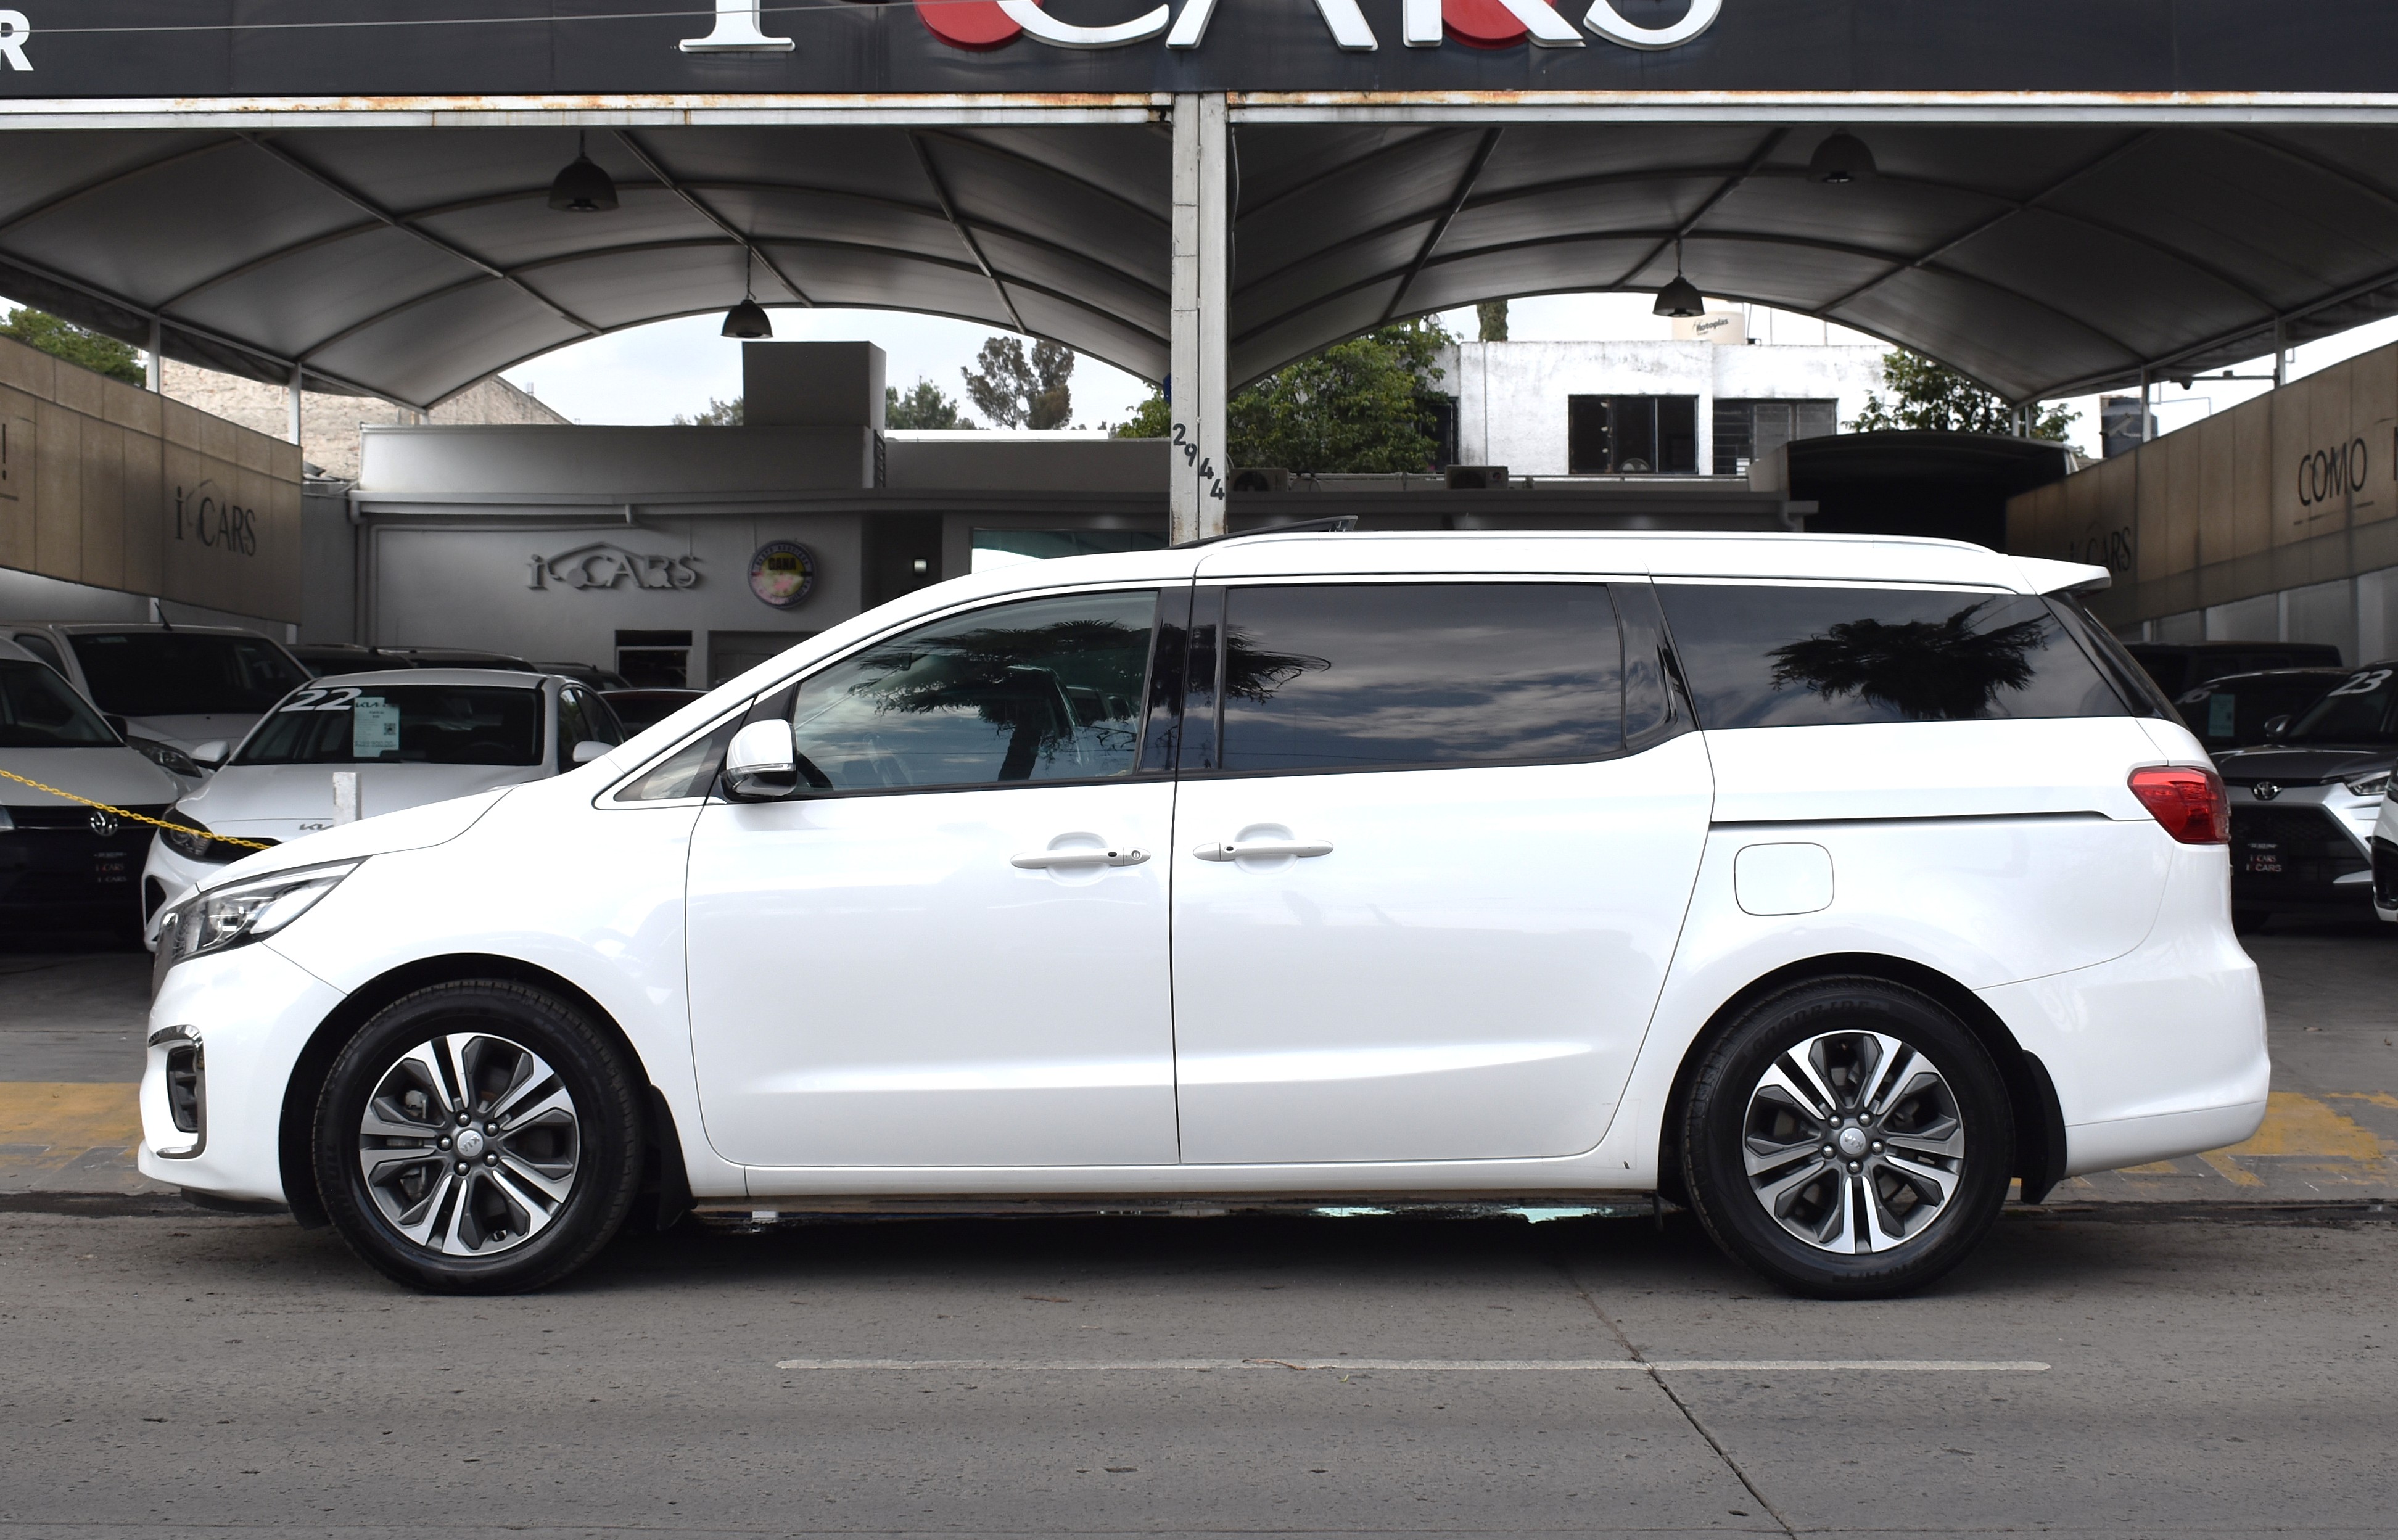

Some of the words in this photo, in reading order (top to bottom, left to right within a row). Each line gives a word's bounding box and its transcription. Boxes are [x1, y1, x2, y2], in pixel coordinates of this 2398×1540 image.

[1172, 423, 1225, 500] 2944
[2299, 437, 2367, 506] COMO
[2327, 669, 2393, 697] 23
[279, 688, 362, 712] 22
[460, 1134, 480, 1152] KIA
